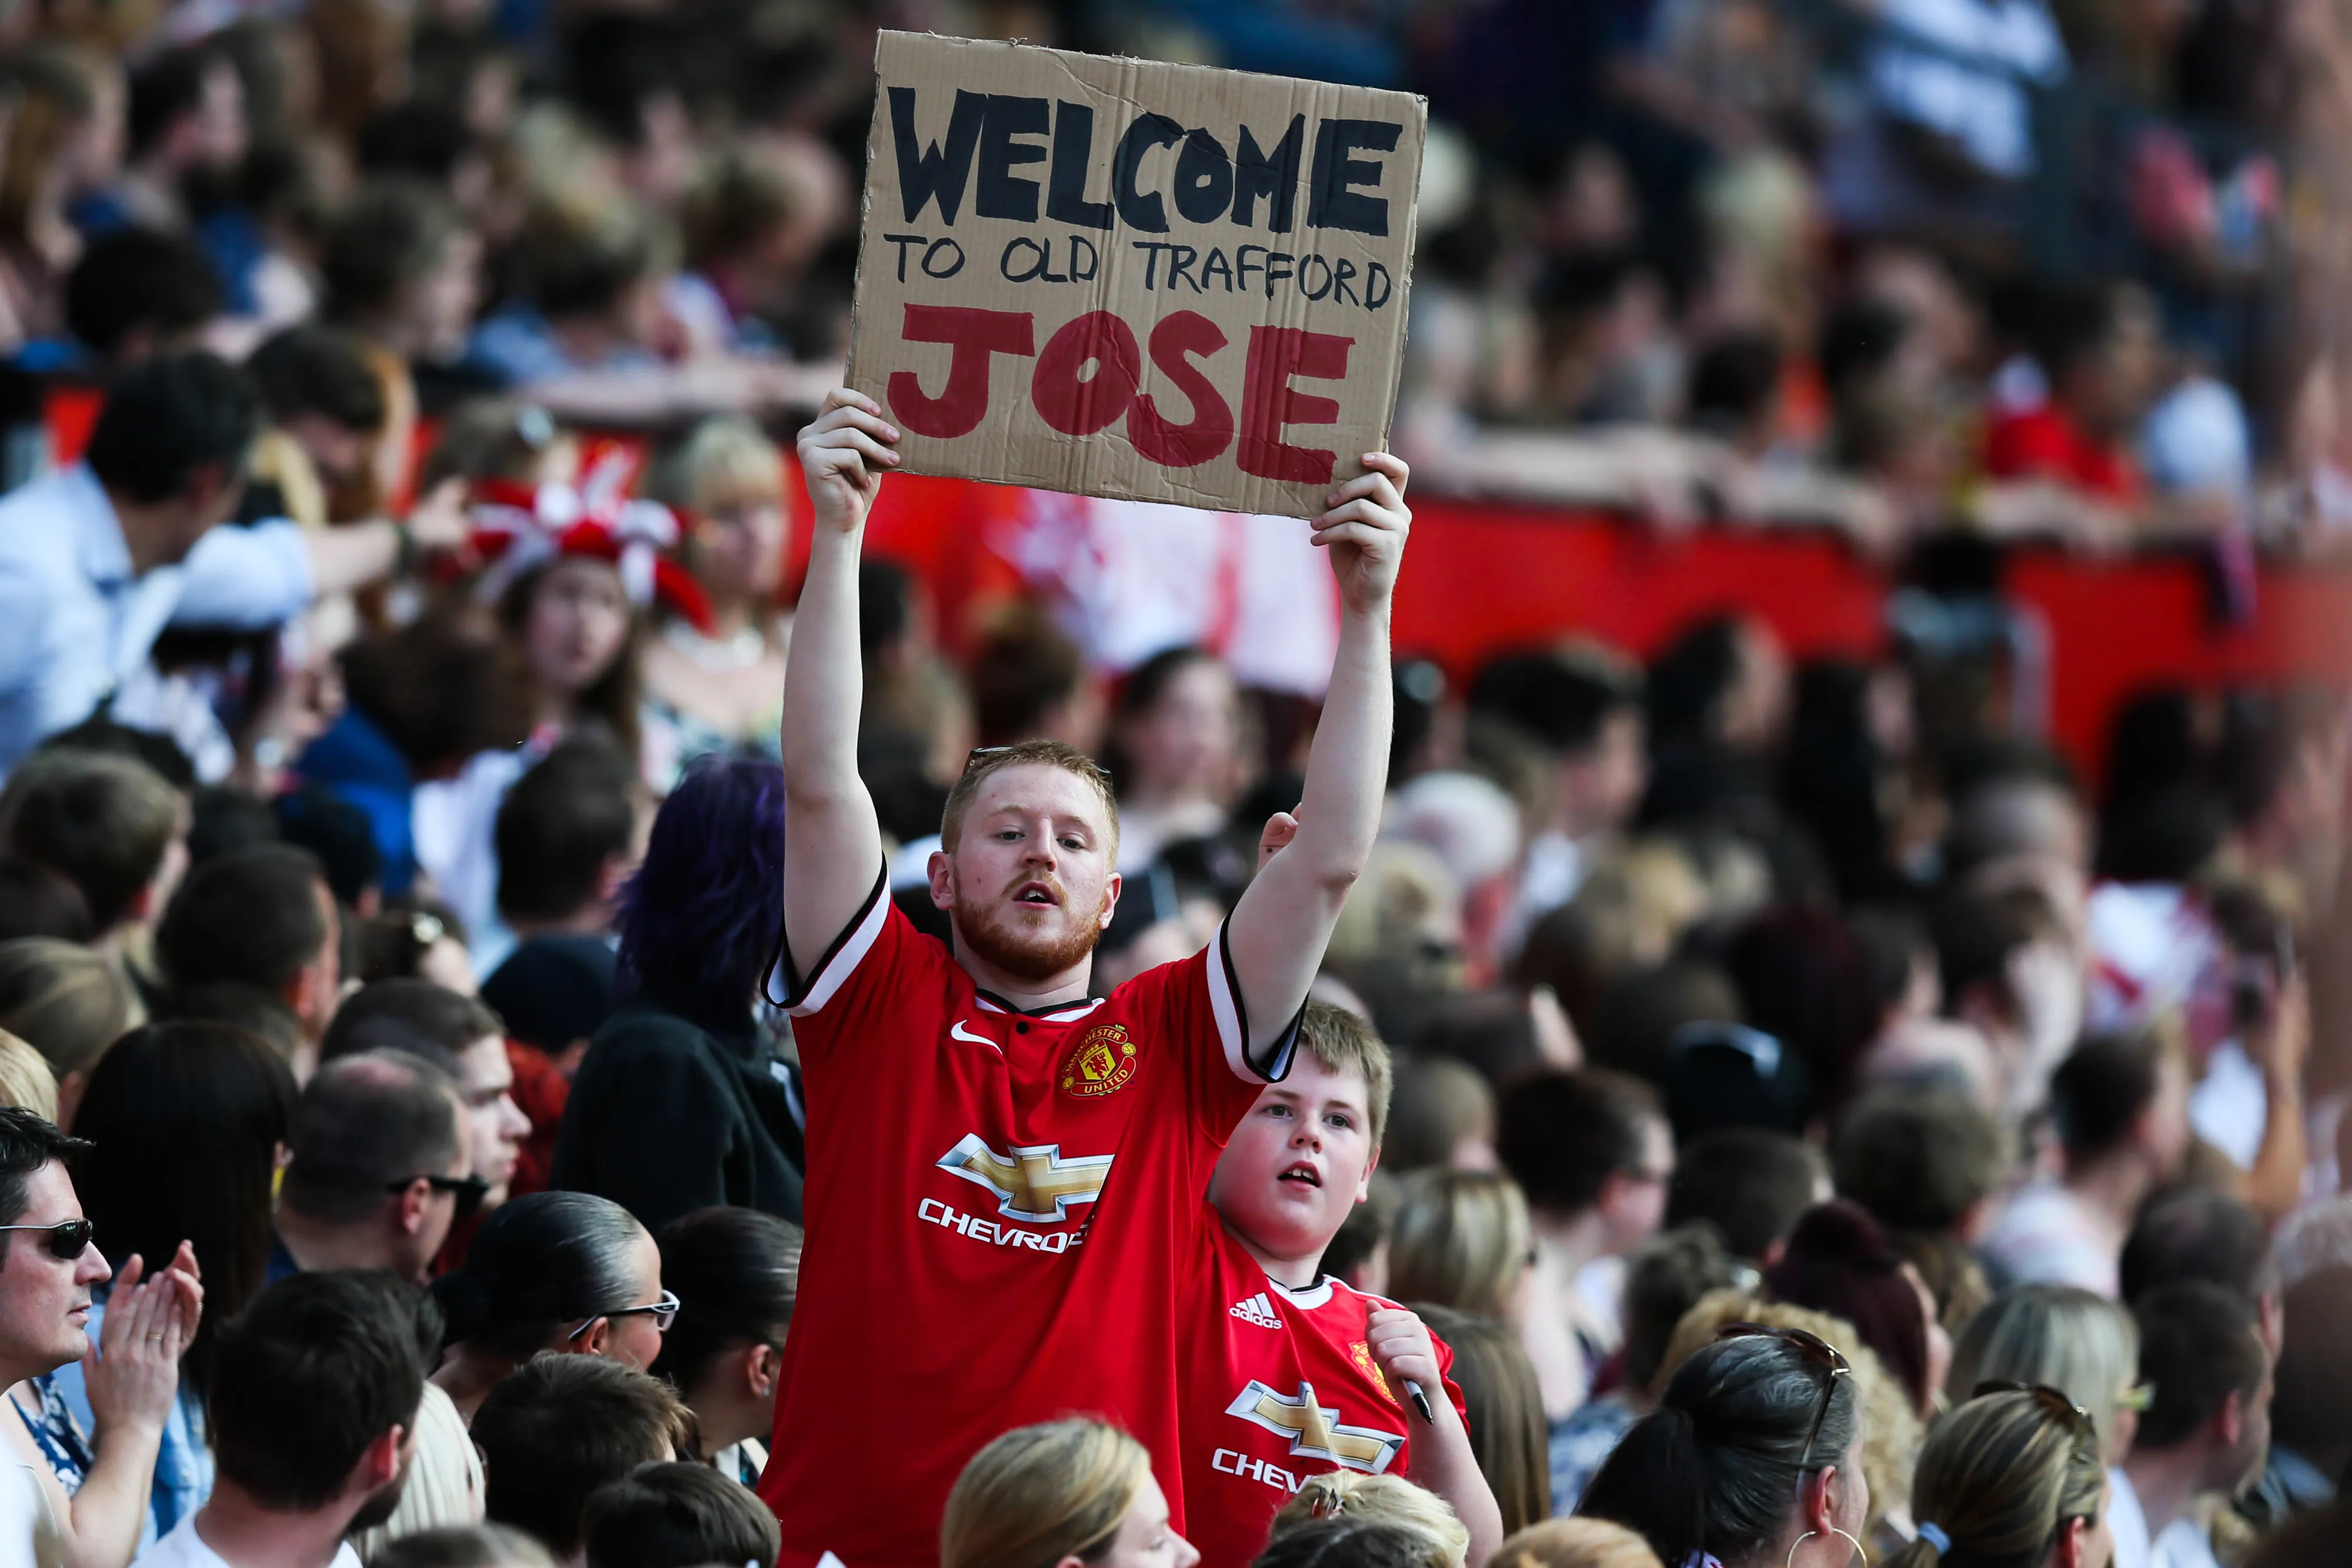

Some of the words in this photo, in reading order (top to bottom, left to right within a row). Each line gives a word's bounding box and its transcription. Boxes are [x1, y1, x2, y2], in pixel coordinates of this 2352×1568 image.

[887, 86, 1403, 236] WELCOME
[883, 234, 965, 283] TO
[1000, 235, 1098, 283] OLD
[1132, 241, 1392, 312] TRAFFORD
[887, 303, 1357, 484] JOSE
[1084, 1069, 1128, 1094] UNITED
[1229, 1307, 1282, 1329] adidas
